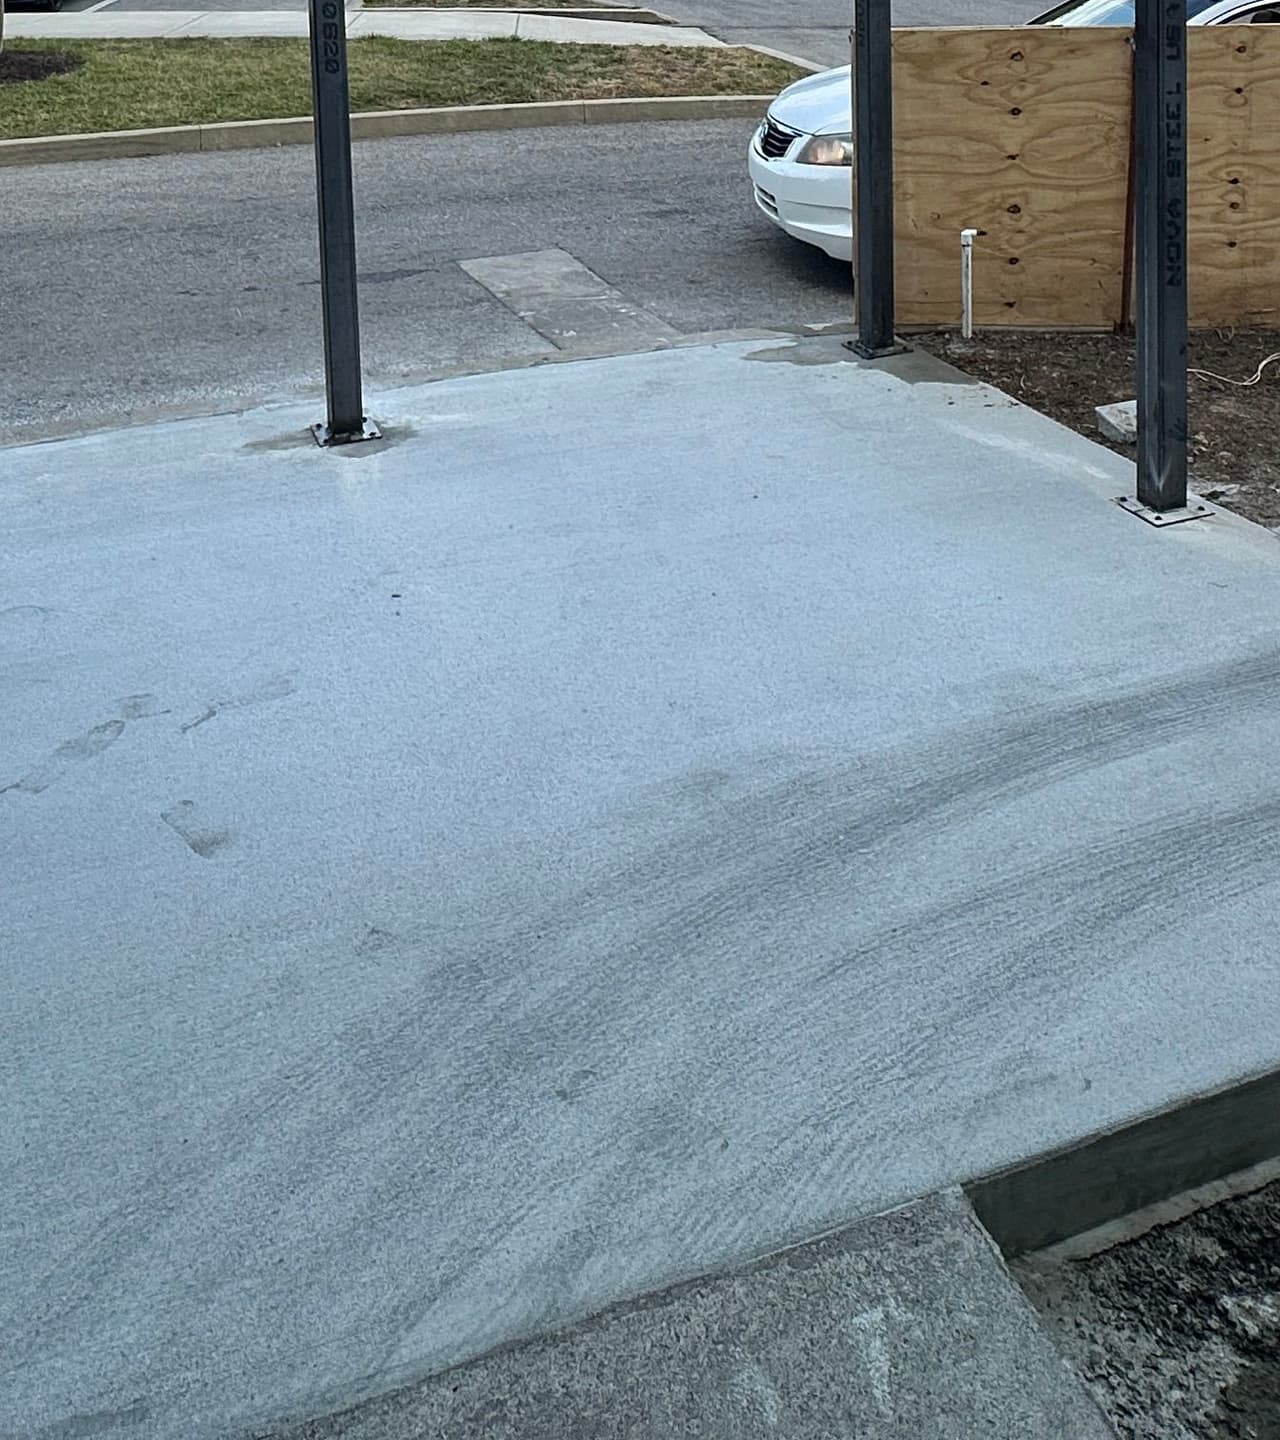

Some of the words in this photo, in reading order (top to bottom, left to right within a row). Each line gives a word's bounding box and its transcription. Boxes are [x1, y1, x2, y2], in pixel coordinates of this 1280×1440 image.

[1165, 1, 1182, 62] USA
[1165, 81, 1182, 179] STEEL
[1165, 197, 1183, 289] NOVA
